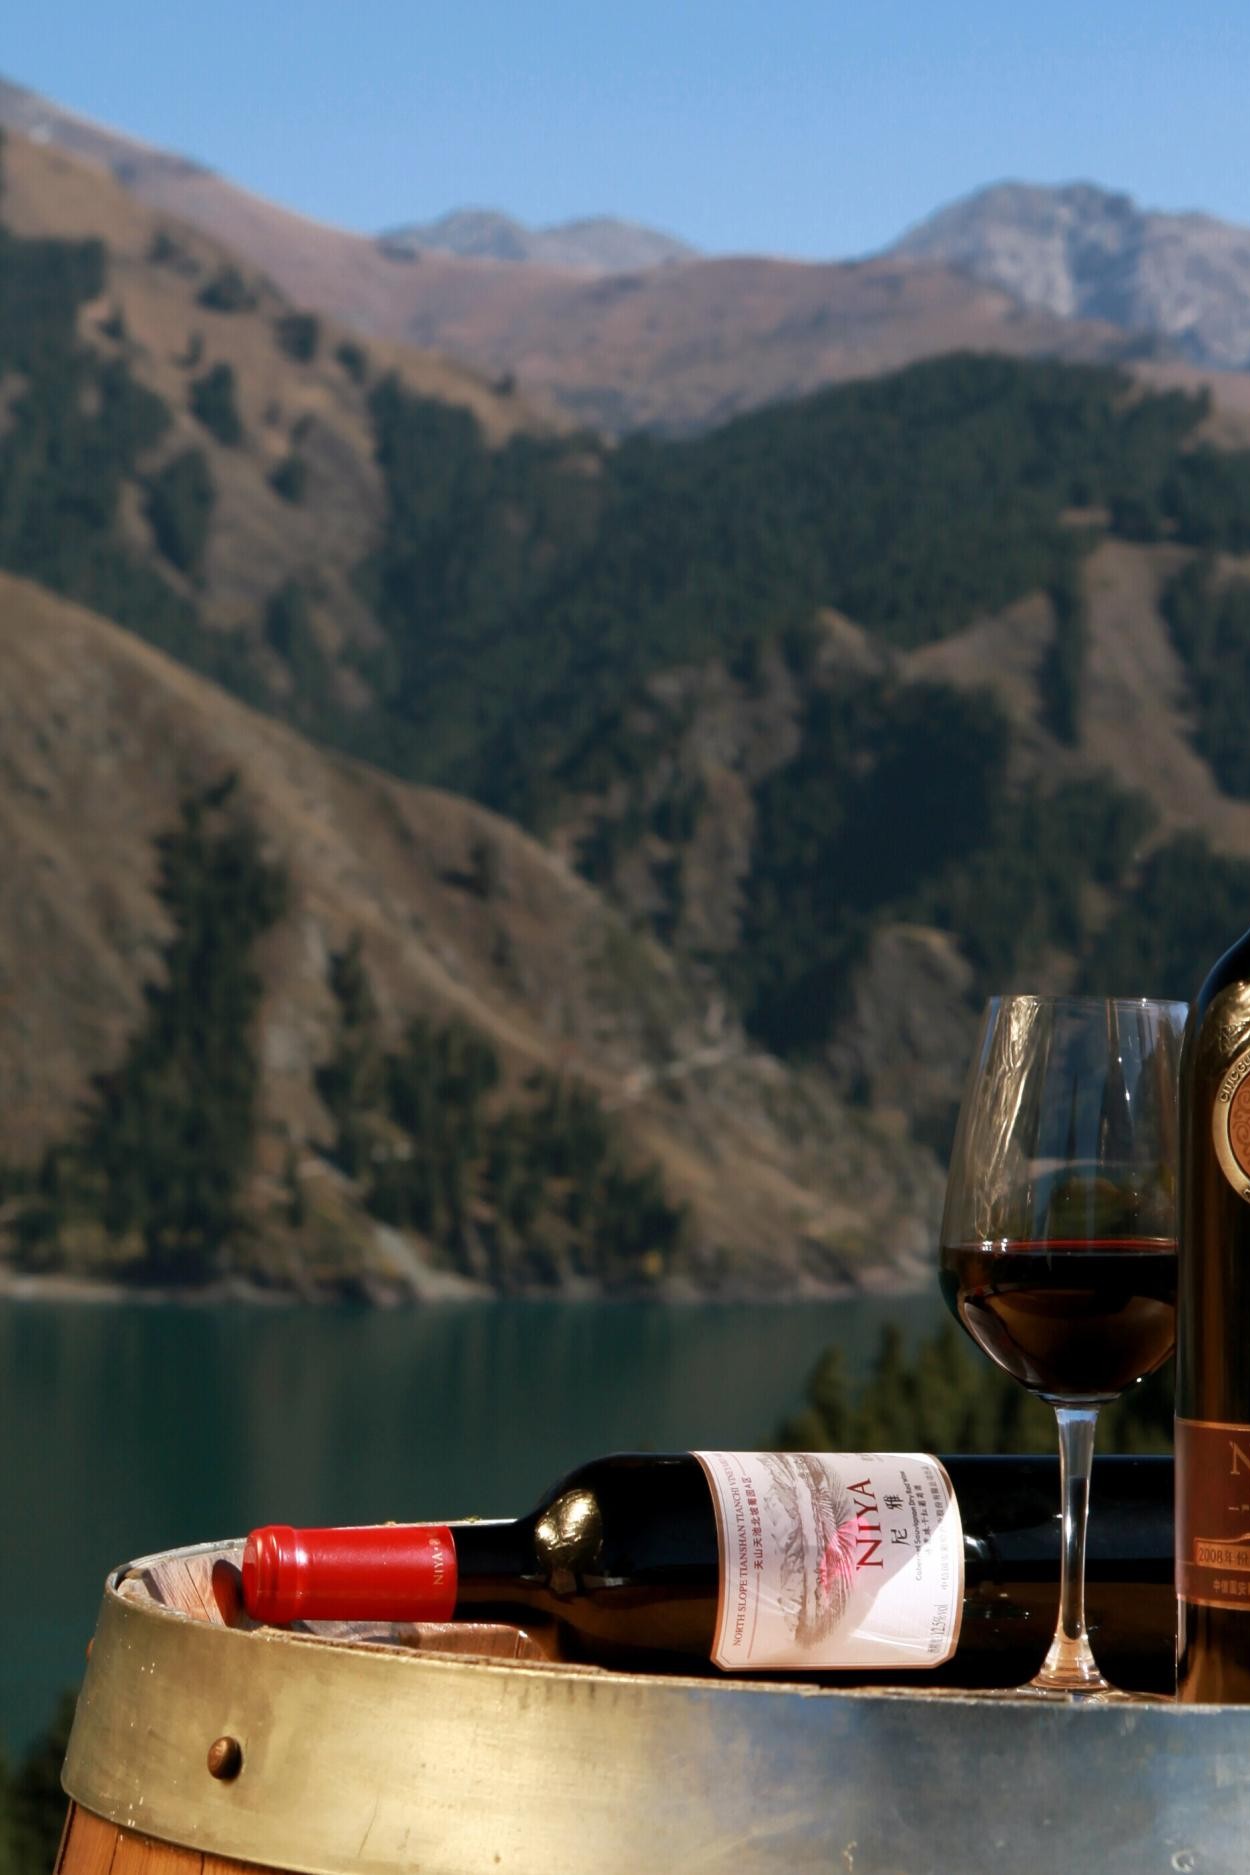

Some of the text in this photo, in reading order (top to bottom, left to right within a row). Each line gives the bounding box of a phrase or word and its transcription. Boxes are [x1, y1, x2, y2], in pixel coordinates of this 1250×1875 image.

[1219, 1070, 1240, 1104] CITIC
[730, 1487, 745, 1523] TIANCHI
[883, 1494, 910, 1546] 尼雅
[847, 1478, 884, 1571] NIYA
[737, 1525, 748, 1577] TIANSHAN
[739, 1581, 748, 1612] SLOPE
[733, 1613, 746, 1647] NORTH
